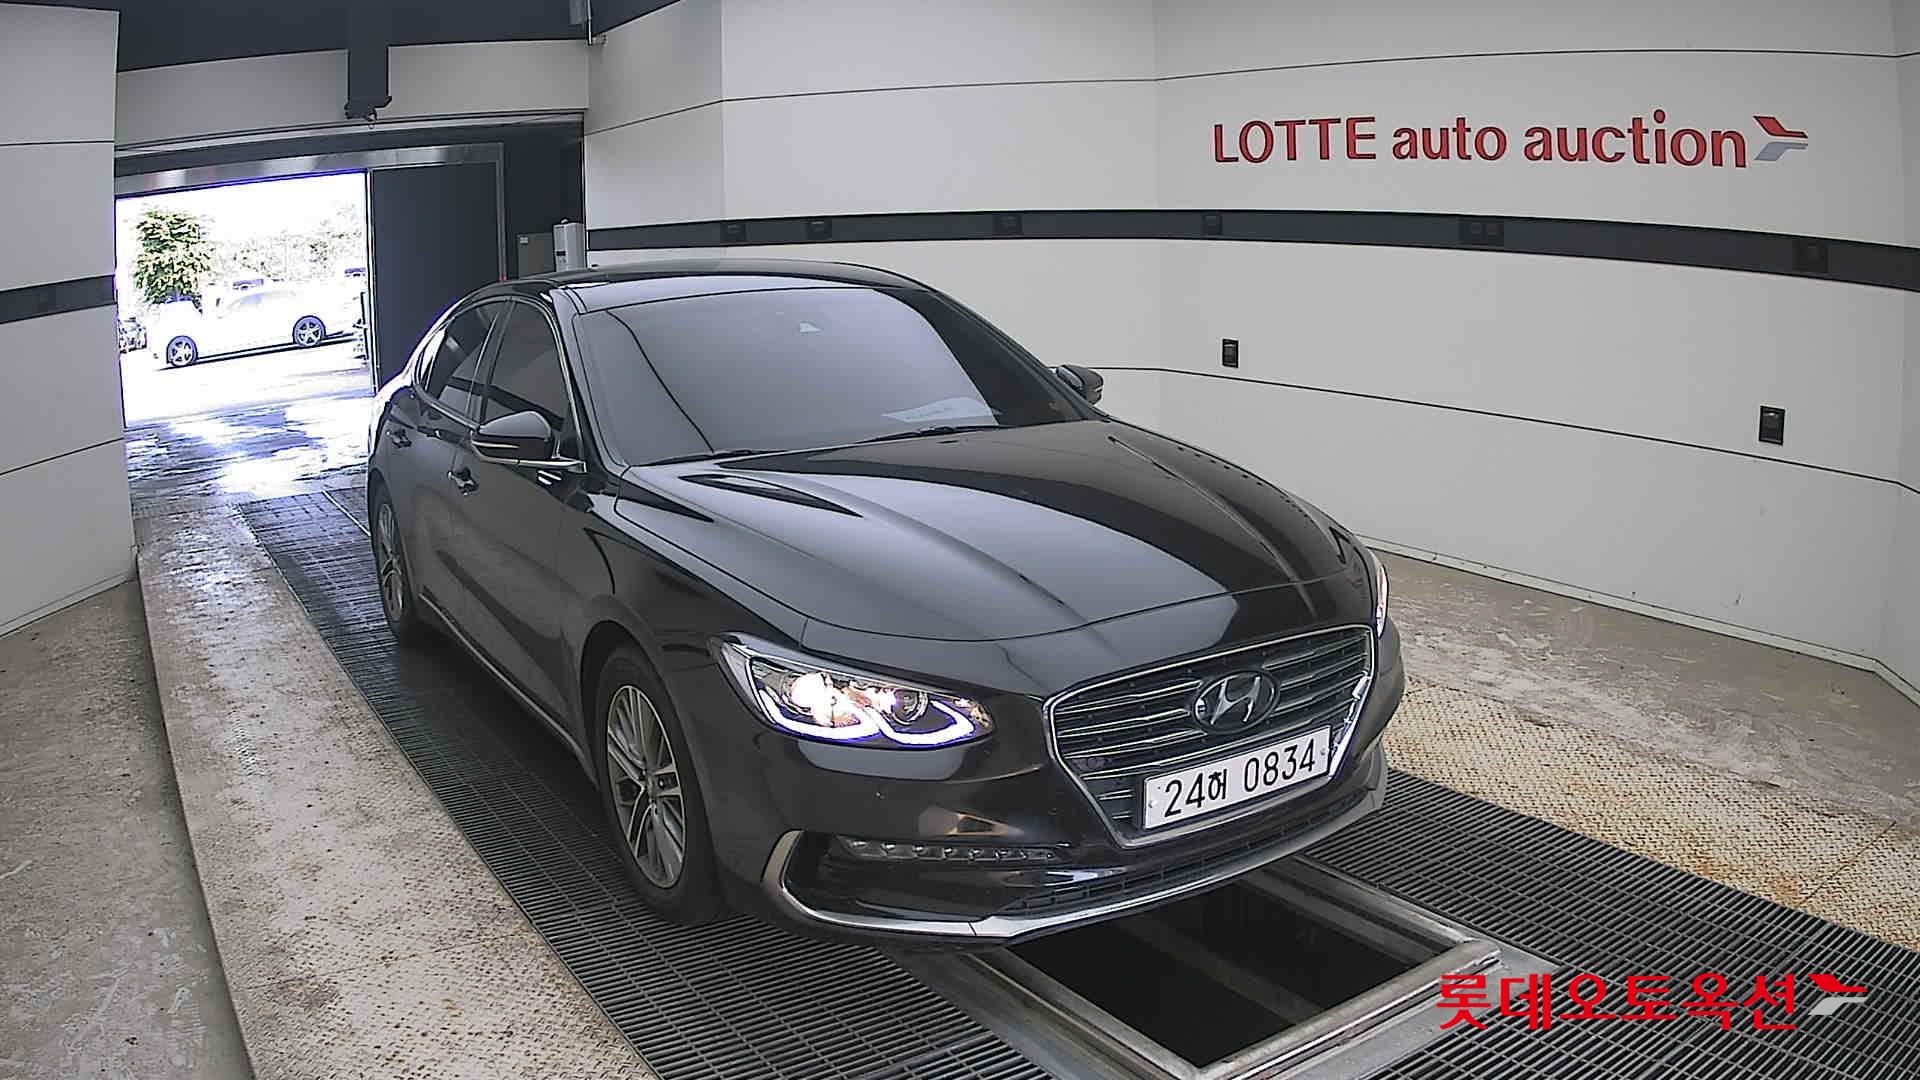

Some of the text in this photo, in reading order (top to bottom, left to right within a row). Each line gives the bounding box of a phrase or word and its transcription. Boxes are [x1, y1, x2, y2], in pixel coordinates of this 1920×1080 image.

[1214, 109, 1748, 168] LOTTE auto auction
[1163, 737, 1316, 818] 24허 0834
